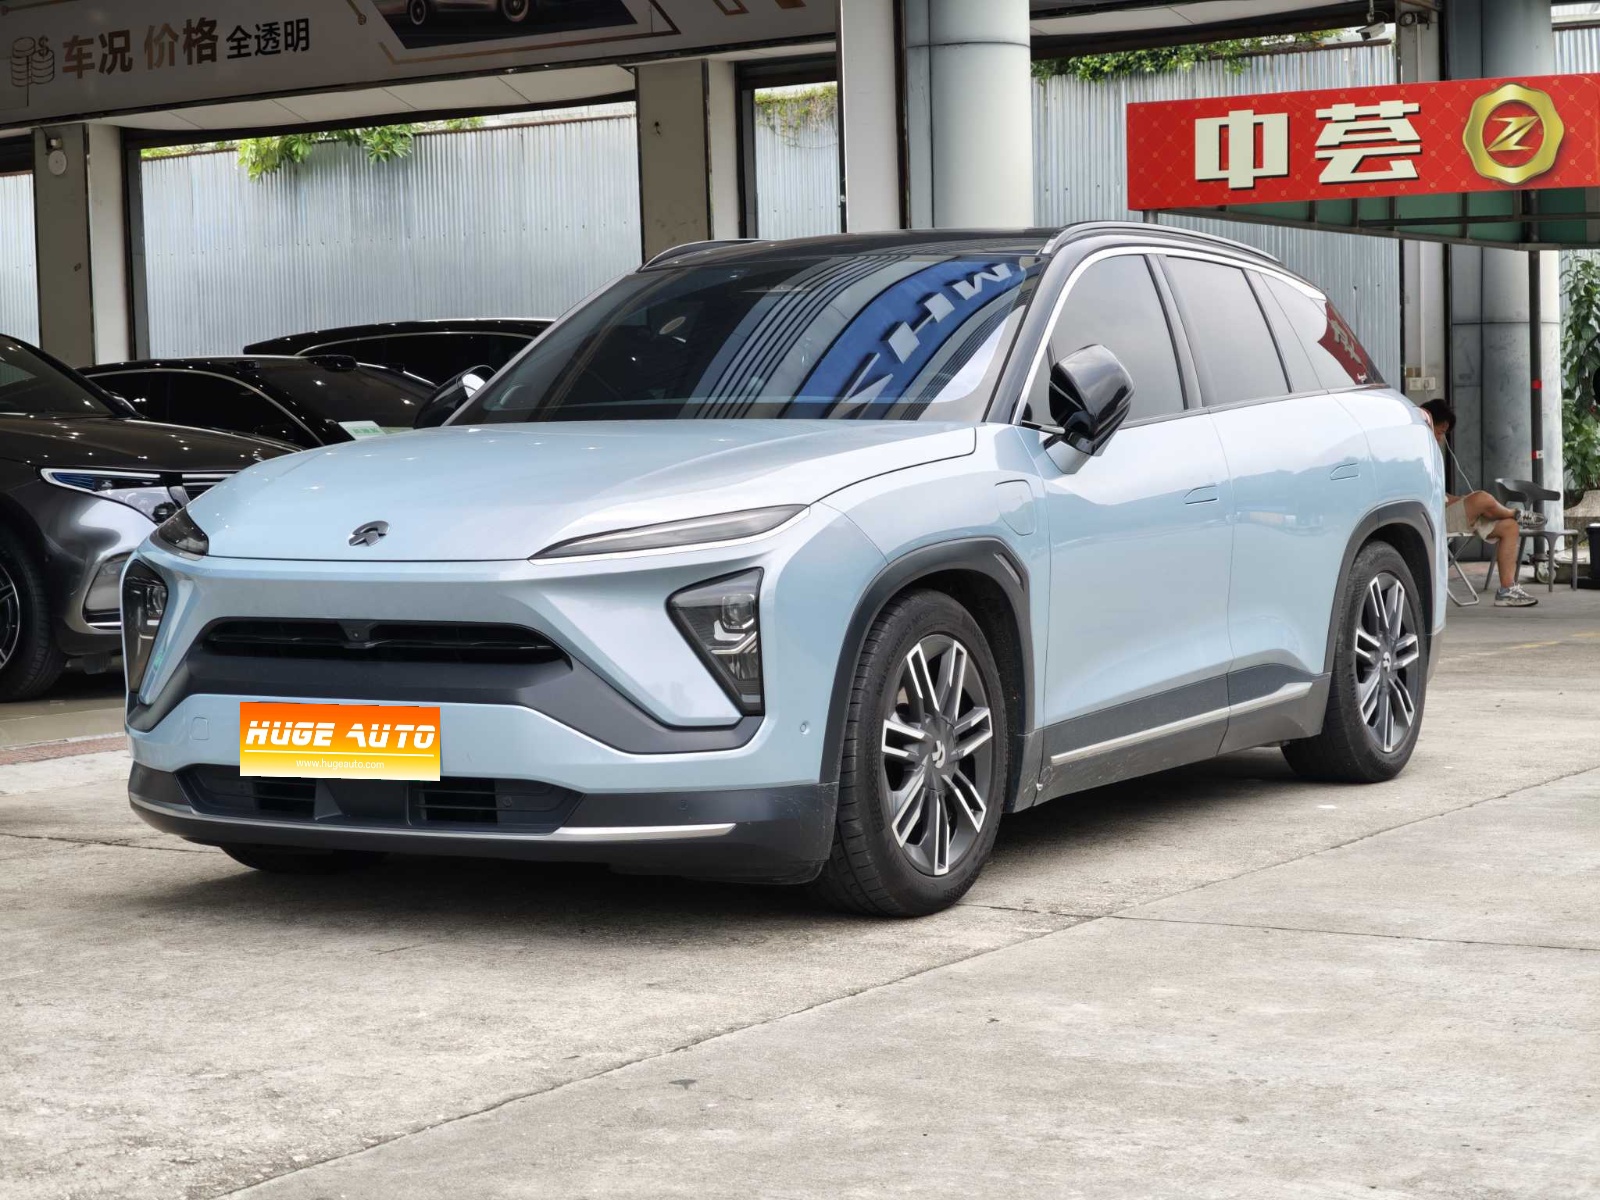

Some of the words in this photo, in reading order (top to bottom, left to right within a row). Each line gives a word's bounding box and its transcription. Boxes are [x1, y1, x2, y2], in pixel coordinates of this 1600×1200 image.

[61, 29, 133, 80] 车况
[143, 17, 219, 71] 价格
[226, 18, 311, 61] 全透明
[1194, 99, 1422, 190] 中荟
